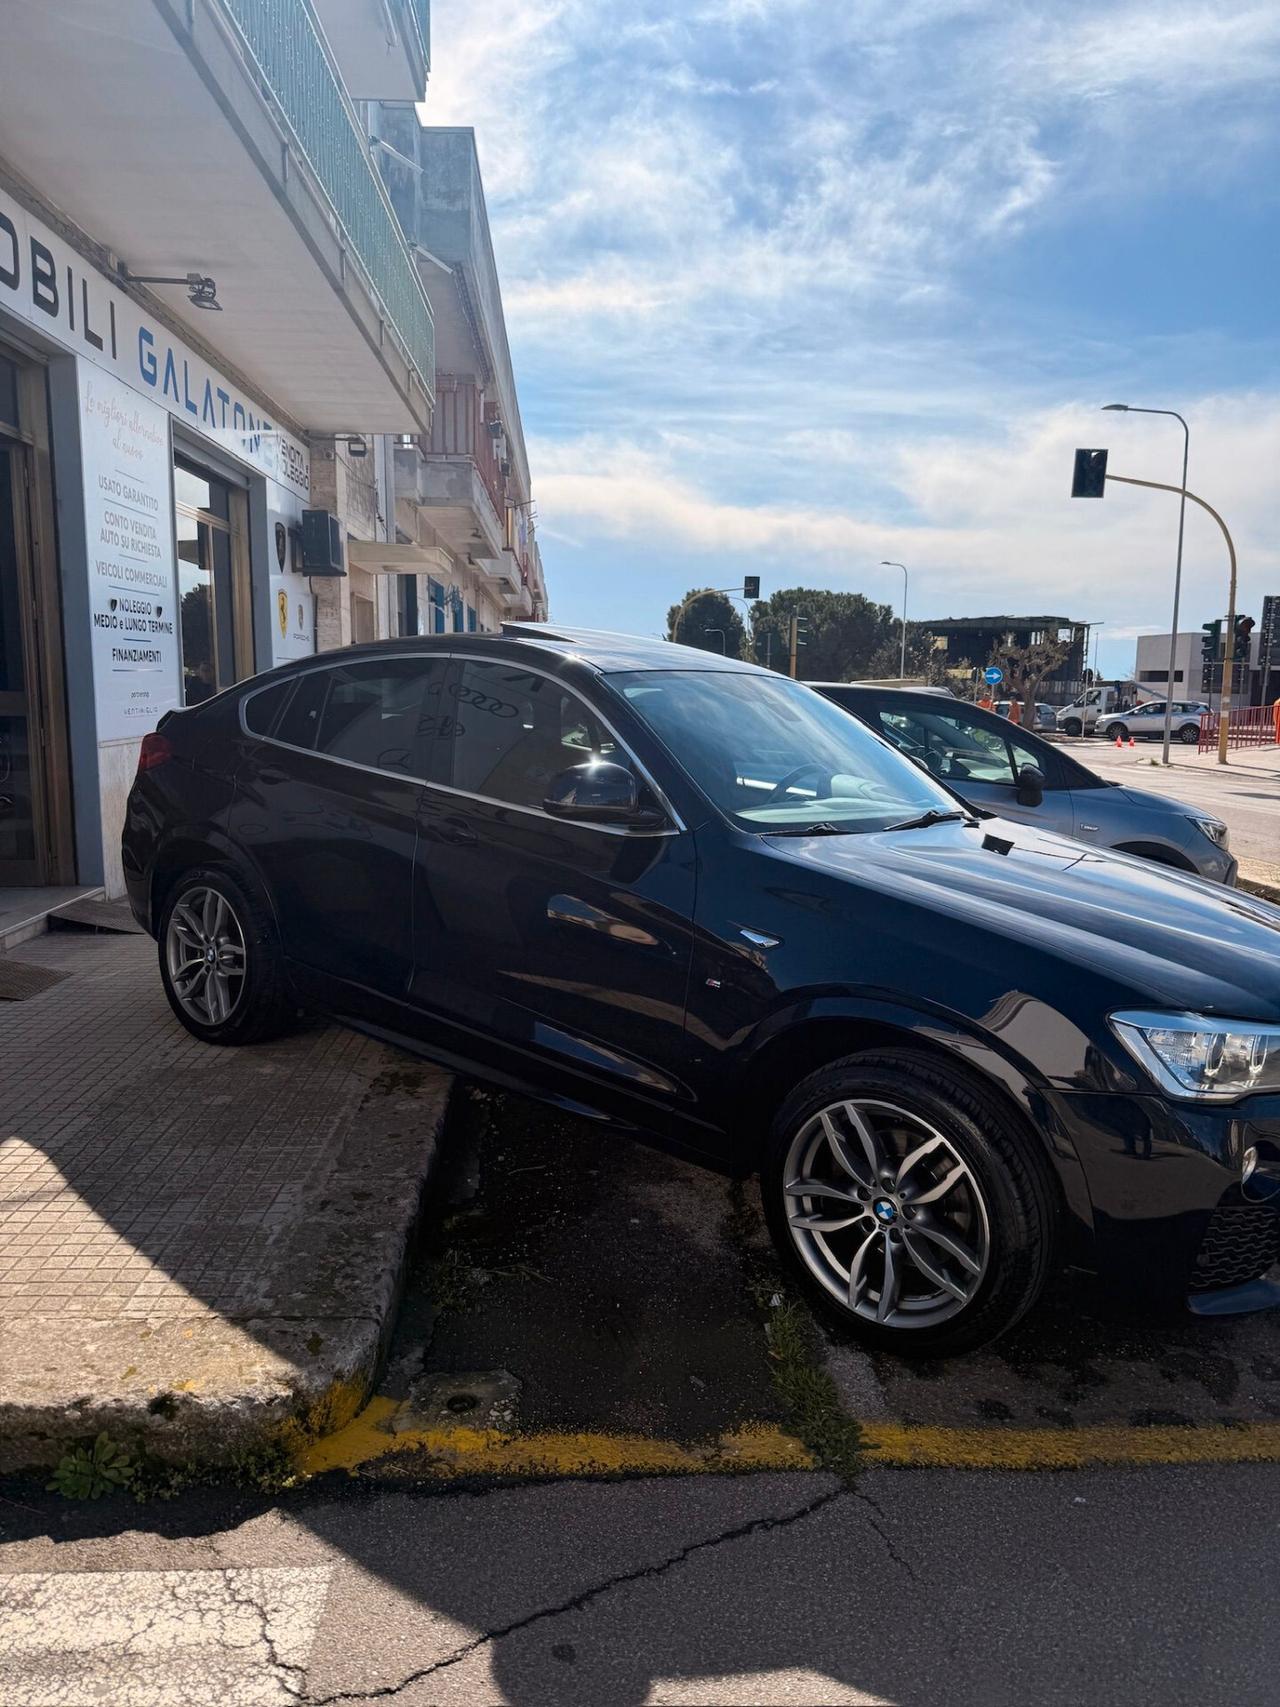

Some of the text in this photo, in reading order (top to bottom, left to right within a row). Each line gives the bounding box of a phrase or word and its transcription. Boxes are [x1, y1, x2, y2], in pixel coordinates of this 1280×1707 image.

[98, 474, 159, 511] USATO GARANTITO
[104, 510, 157, 541] CONTO VENDITA
[100, 528, 162, 559] AUTO SU RICHIESTA
[96, 560, 168, 588] VEICOLI COMMERCIALI
[119, 598, 152, 616] NOLEGGIO
[94, 613, 173, 635] MEDIO e LUNGO TERMINE
[112, 648, 162, 663] FINANZIAMENTI
